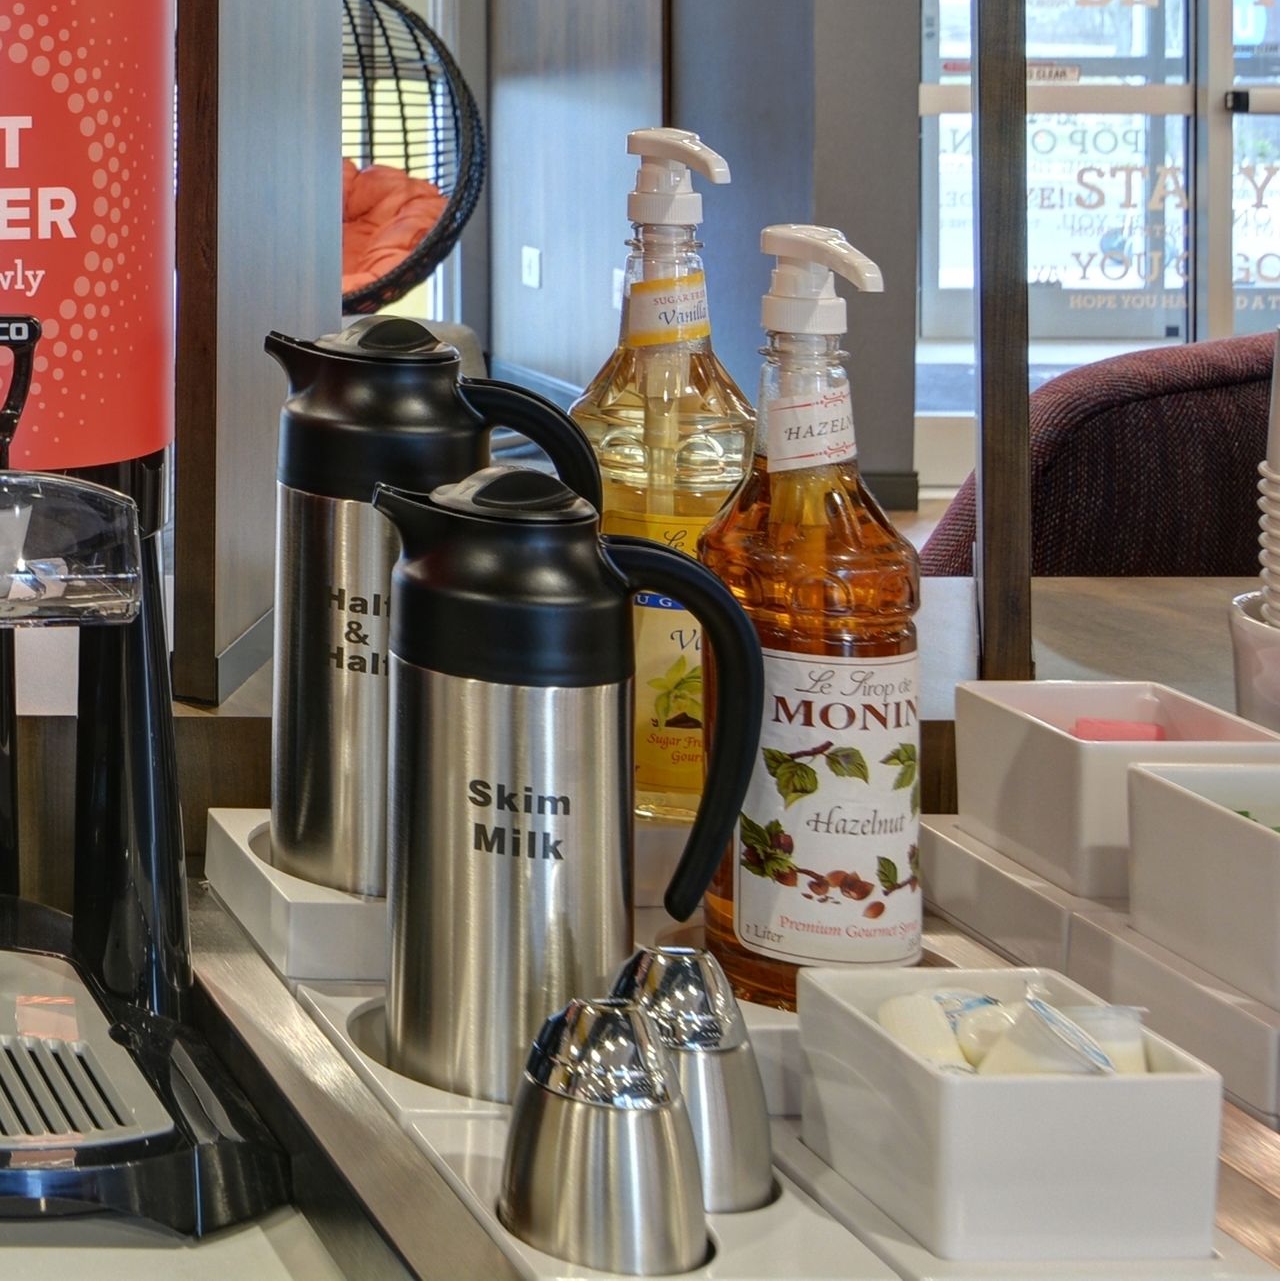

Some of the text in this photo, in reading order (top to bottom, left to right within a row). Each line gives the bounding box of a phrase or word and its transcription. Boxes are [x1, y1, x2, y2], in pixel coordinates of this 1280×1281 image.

[653, 294, 688, 307] SUGAR
[1069, 295, 1118, 309] HOPE
[1121, 295, 1158, 309] YOU
[344, 620, 370, 647] &
[794, 669, 835, 695] Le
[840, 670, 895, 702] Sirop
[771, 694, 918, 731] MONIN
[647, 733, 682, 751] Sugar
[468, 780, 571, 816] Skim
[806, 806, 907, 836] Hazelnut
[473, 822, 564, 861] Milk
[753, 923, 785, 944] Liter
[779, 915, 842, 937] Premium
[845, 924, 898, 939] Gourmet
